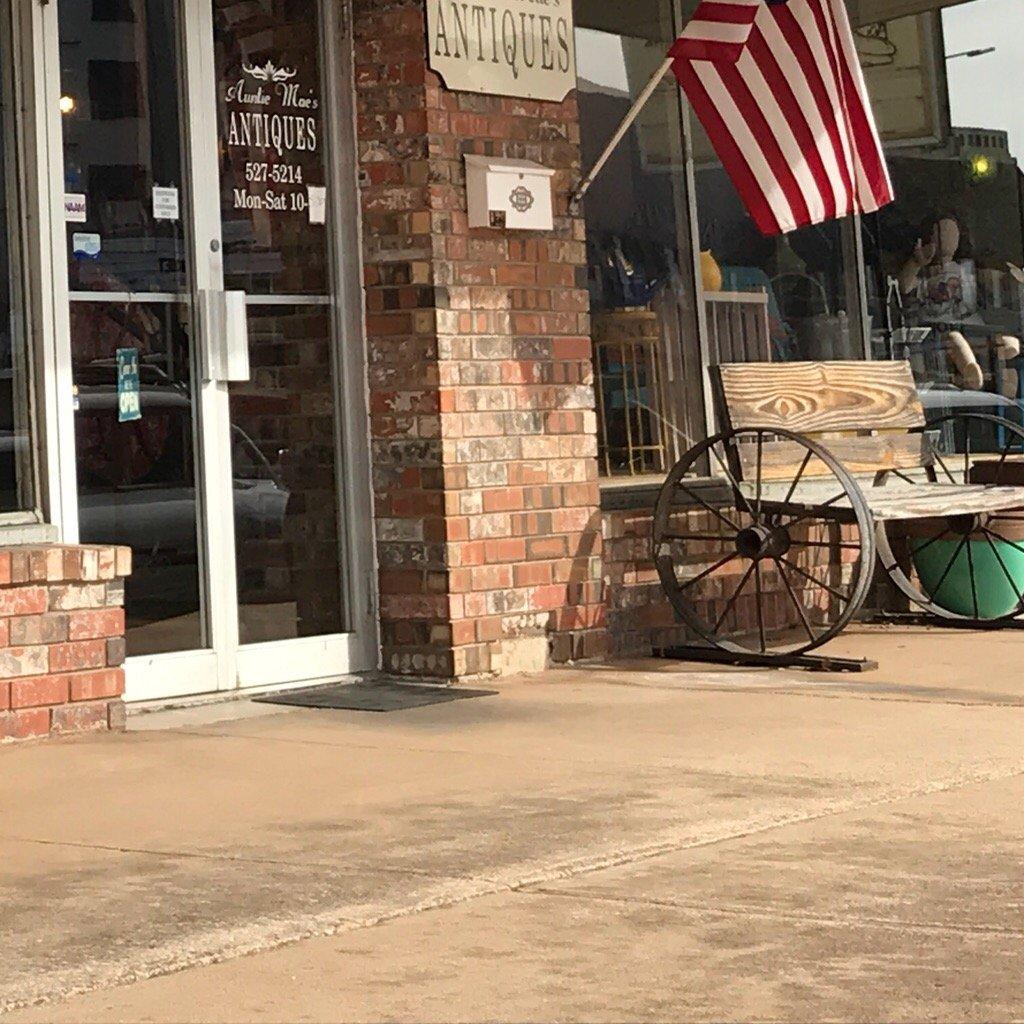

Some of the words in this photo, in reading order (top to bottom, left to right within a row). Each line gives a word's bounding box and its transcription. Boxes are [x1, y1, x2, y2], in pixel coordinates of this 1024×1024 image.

[434, 0, 570, 79] ANTIQUES
[225, 79, 271, 105] Auntie
[277, 82, 318, 108] Mae's
[228, 111, 317, 156] ANTIQUES
[245, 163, 303, 184] 527-5214
[233, 188, 287, 211] Mon-Sat
[291, 192, 309, 212] 10-
